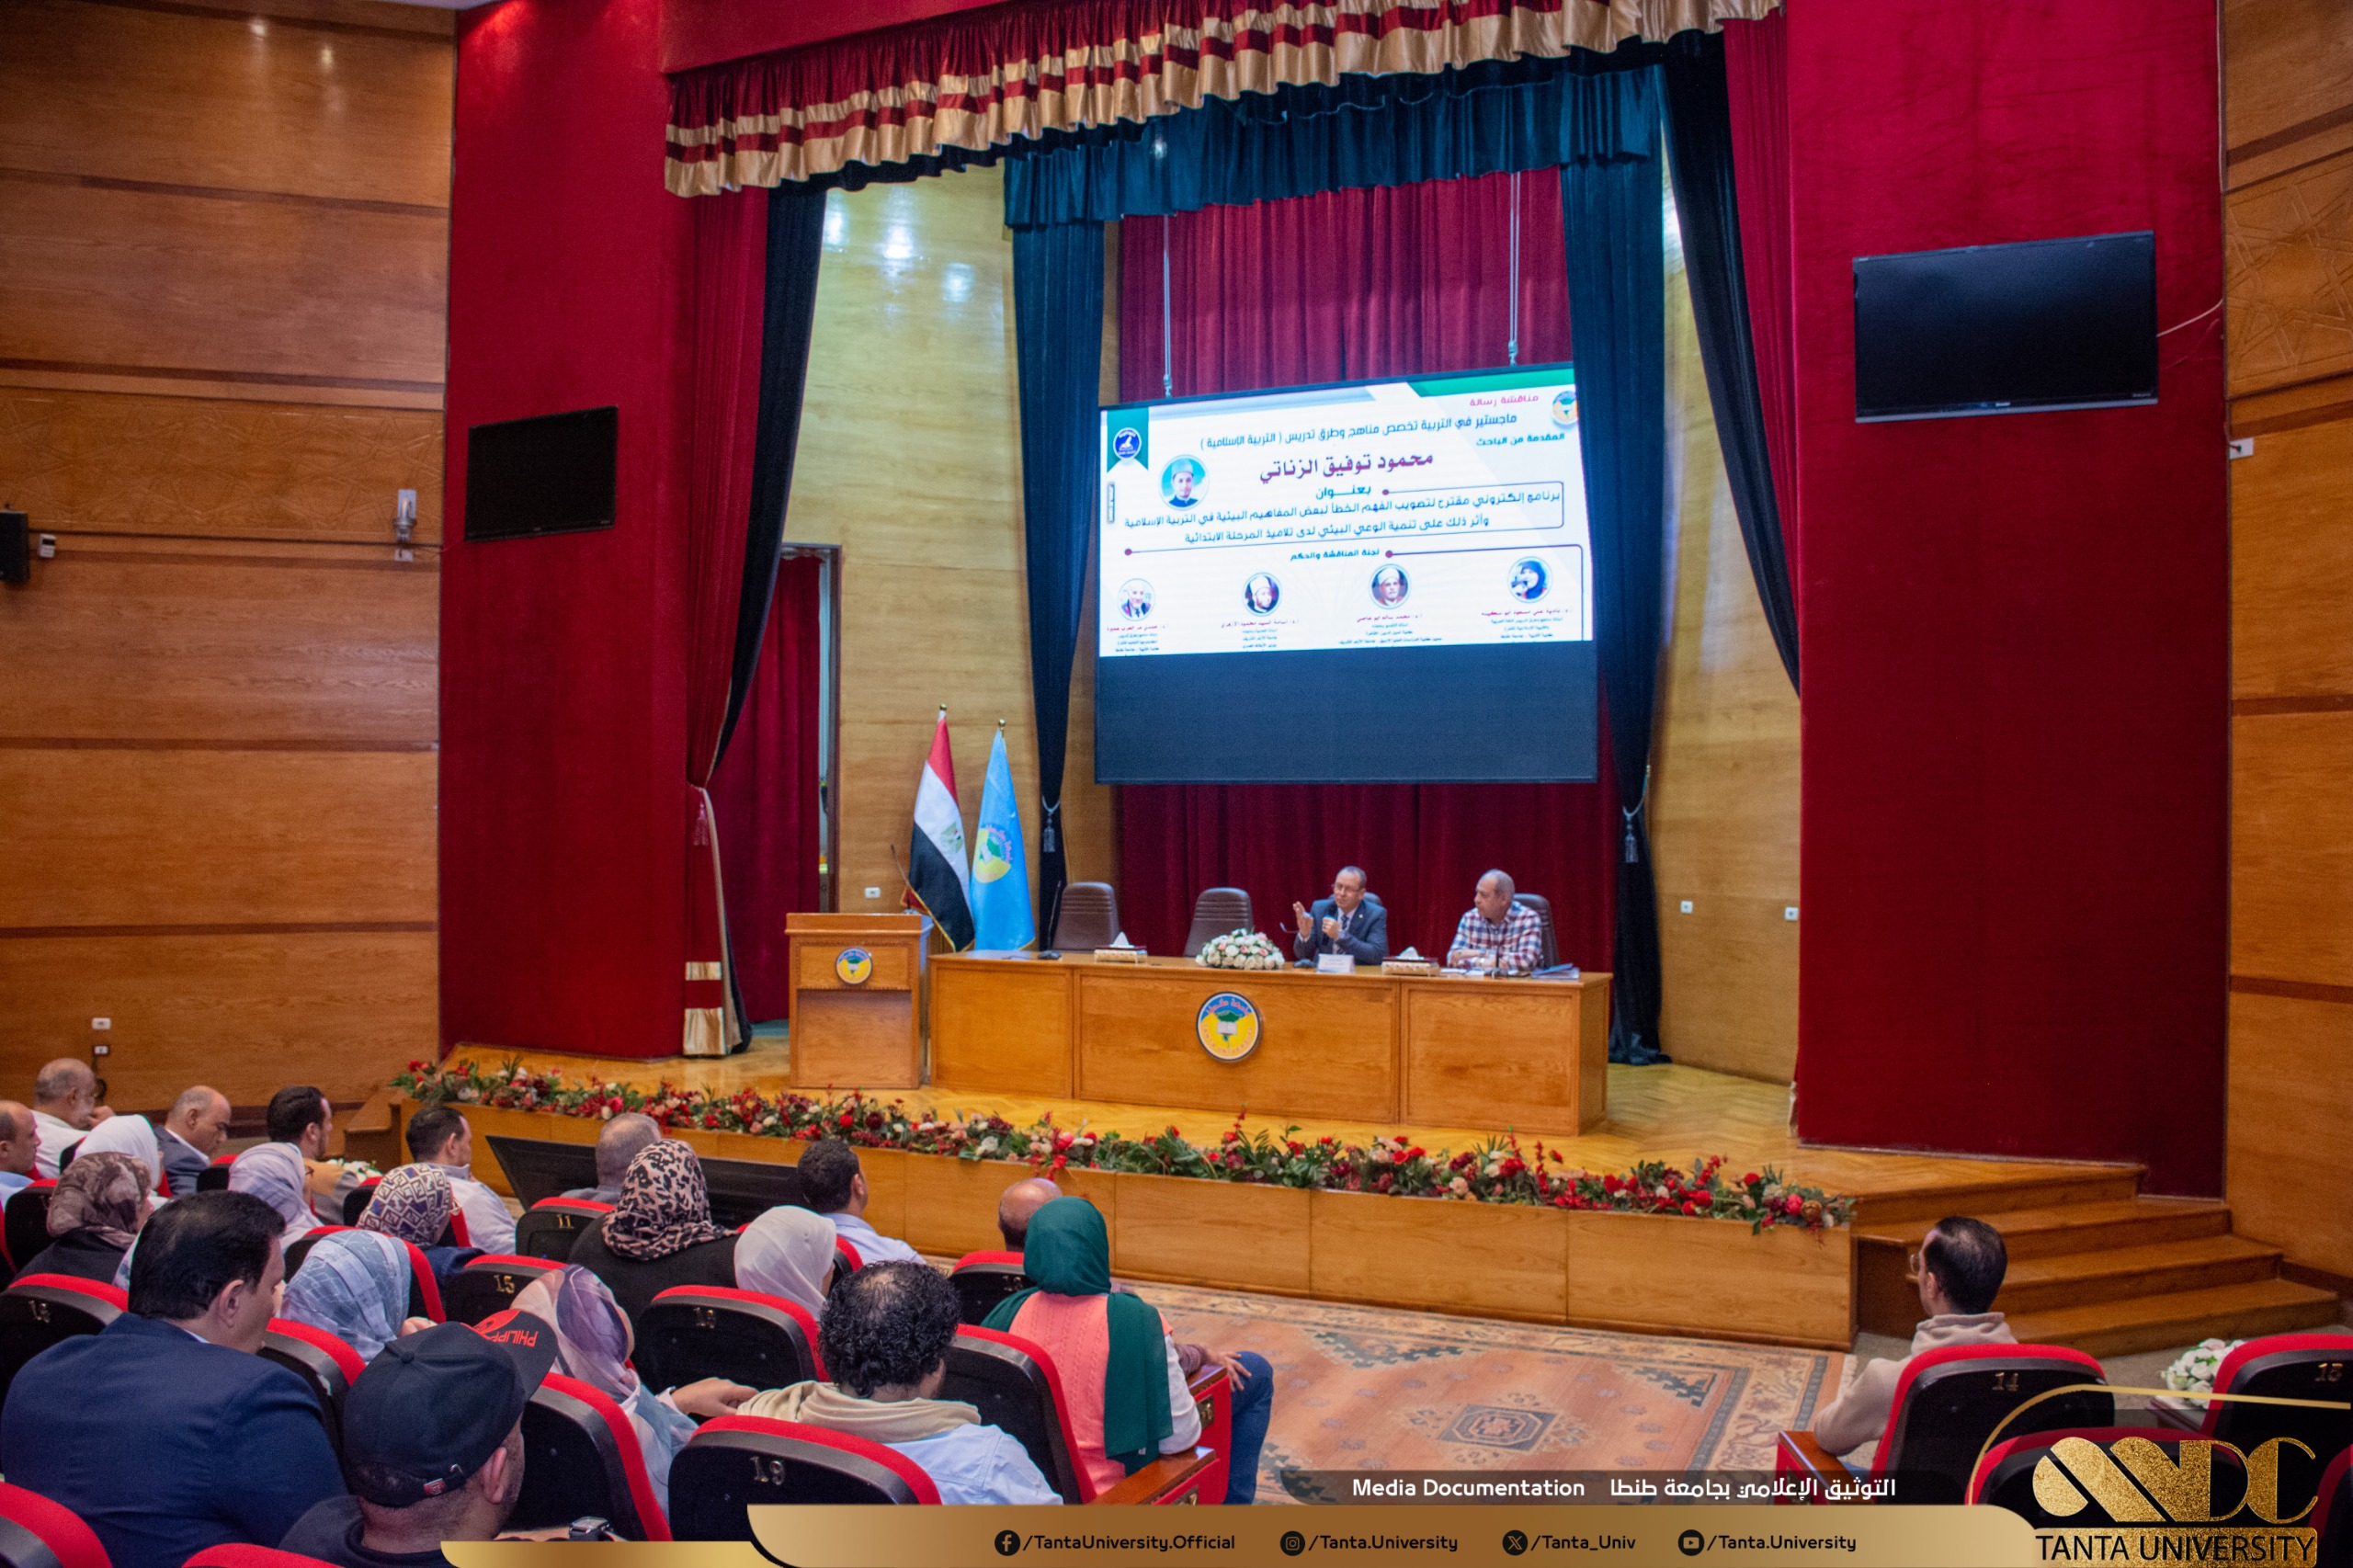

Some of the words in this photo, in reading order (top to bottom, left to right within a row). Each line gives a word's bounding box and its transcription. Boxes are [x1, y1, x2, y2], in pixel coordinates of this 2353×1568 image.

[1470, 397, 1497, 407] رسالة
[1500, 394, 1539, 405] مناقشة
[1421, 417, 1451, 432] التربية
[1454, 415, 1472, 429] في
[1475, 414, 1517, 429] ماجستير
[1317, 426, 1345, 441] وطرق
[1347, 425, 1379, 438] مناهج
[1381, 420, 1418, 437] تخصص
[1247, 433, 1276, 446] التربية
[1285, 429, 1315, 443] تدريس
[1476, 437, 1507, 447] الباحث
[1510, 436, 1524, 446] من
[1527, 433, 1564, 443] المقدمة
[1323, 453, 1371, 477] توفيق
[1377, 453, 1433, 472] محمود
[1259, 458, 1318, 484] الزناتي
[1438, 496, 1470, 509] مقترح
[1472, 492, 1525, 507] إلكتروني
[1527, 490, 1560, 504] برنامج
[1331, 502, 1358, 514] الخطأ
[1361, 500, 1392, 513] الفهم
[1394, 497, 1436, 511] لتصويب
[1216, 510, 1246, 523] البيئية
[1249, 506, 1296, 521] المفاهيم
[1299, 505, 1328, 517] لبعض
[1165, 514, 1196, 526] التربية
[1198, 512, 1214, 526] في
[1388, 519, 1416, 532] تنمية
[1418, 518, 1443, 530] على
[1445, 517, 1466, 528] ذلك
[1470, 513, 1489, 528] وأثر
[1265, 527, 1293, 539] تلاميذ
[1296, 526, 1315, 538] لدى
[1317, 524, 1351, 538] البيئي
[1353, 521, 1386, 535] الوعي
[1185, 531, 1224, 544] الابتدائية
[1225, 529, 1262, 541] المرحلة
[1290, 551, 1321, 562] والحكم
[1323, 549, 1359, 559] المناقشة
[1361, 548, 1380, 557] لجنة
[494, 1275, 515, 1294] 15
[750, 1456, 785, 1486] 19
